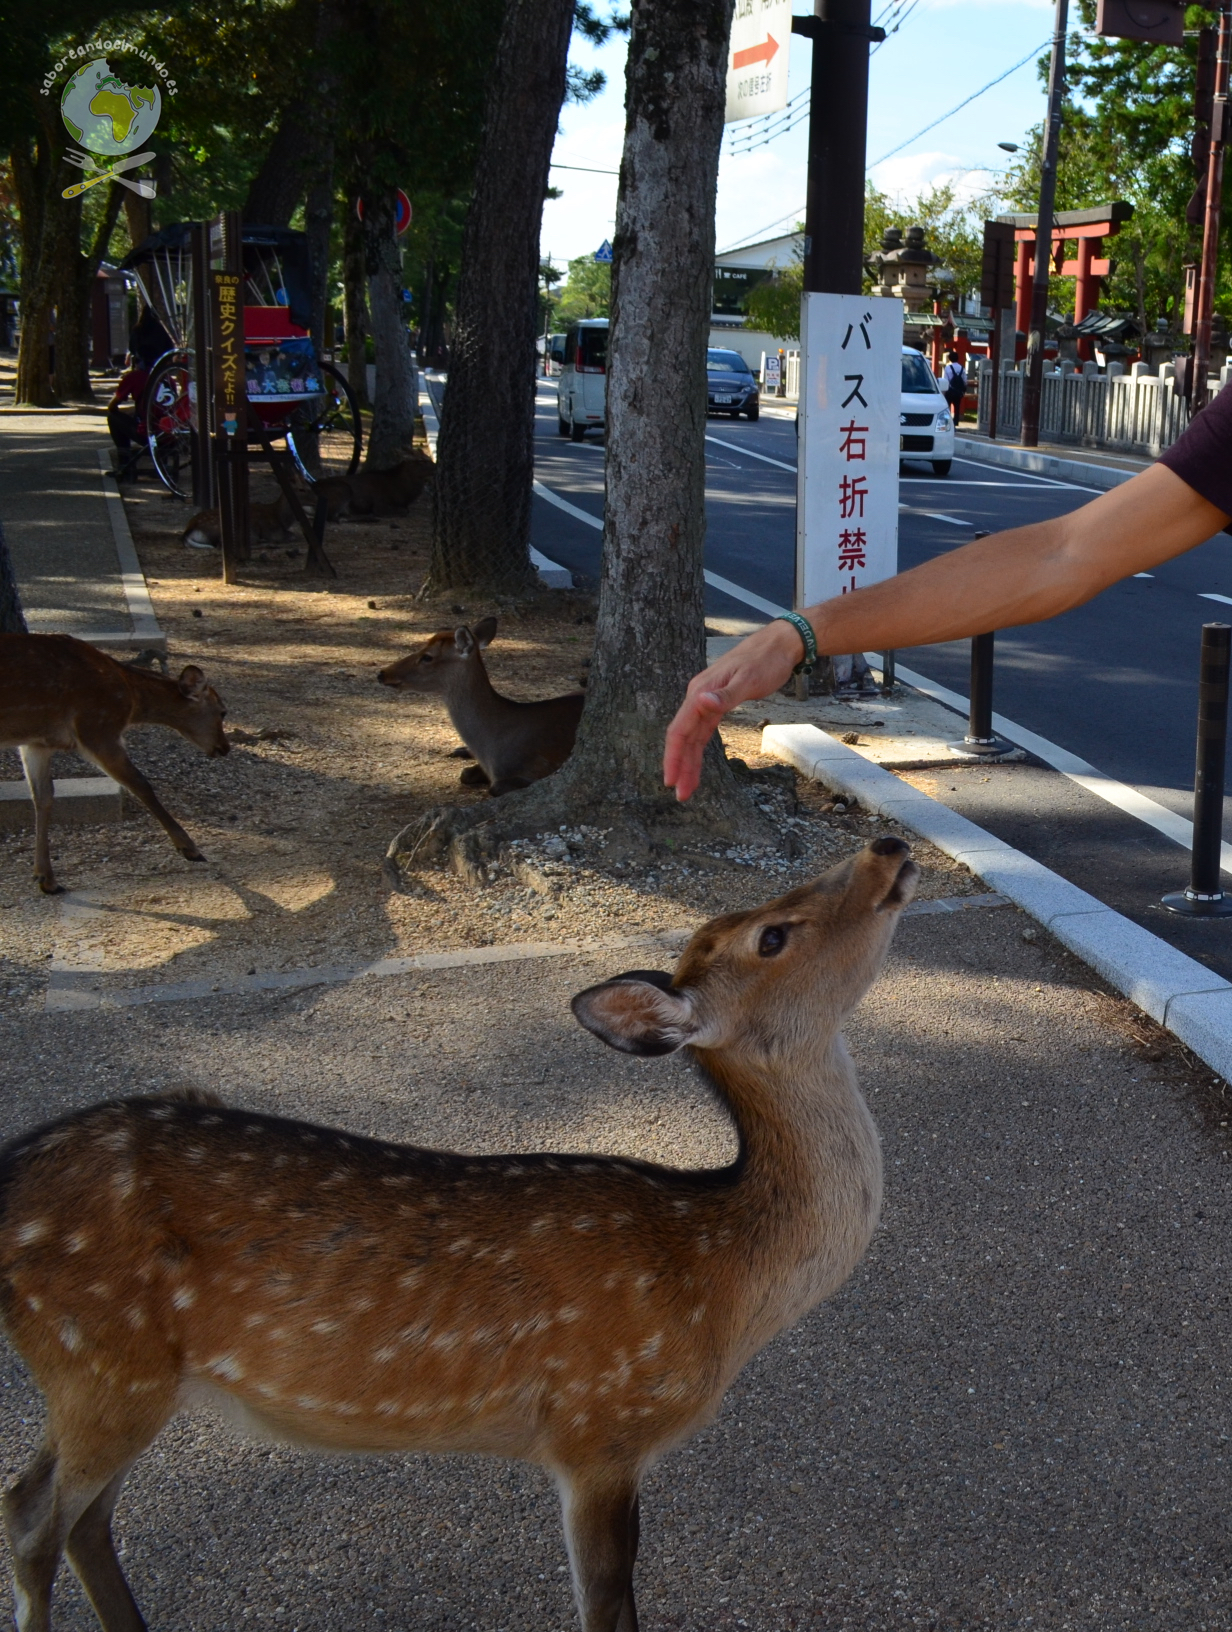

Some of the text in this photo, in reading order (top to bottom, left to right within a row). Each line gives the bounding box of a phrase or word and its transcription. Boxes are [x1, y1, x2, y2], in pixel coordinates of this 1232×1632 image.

[214, 275, 240, 285] 奈良の
[768, 358, 778, 370] P
